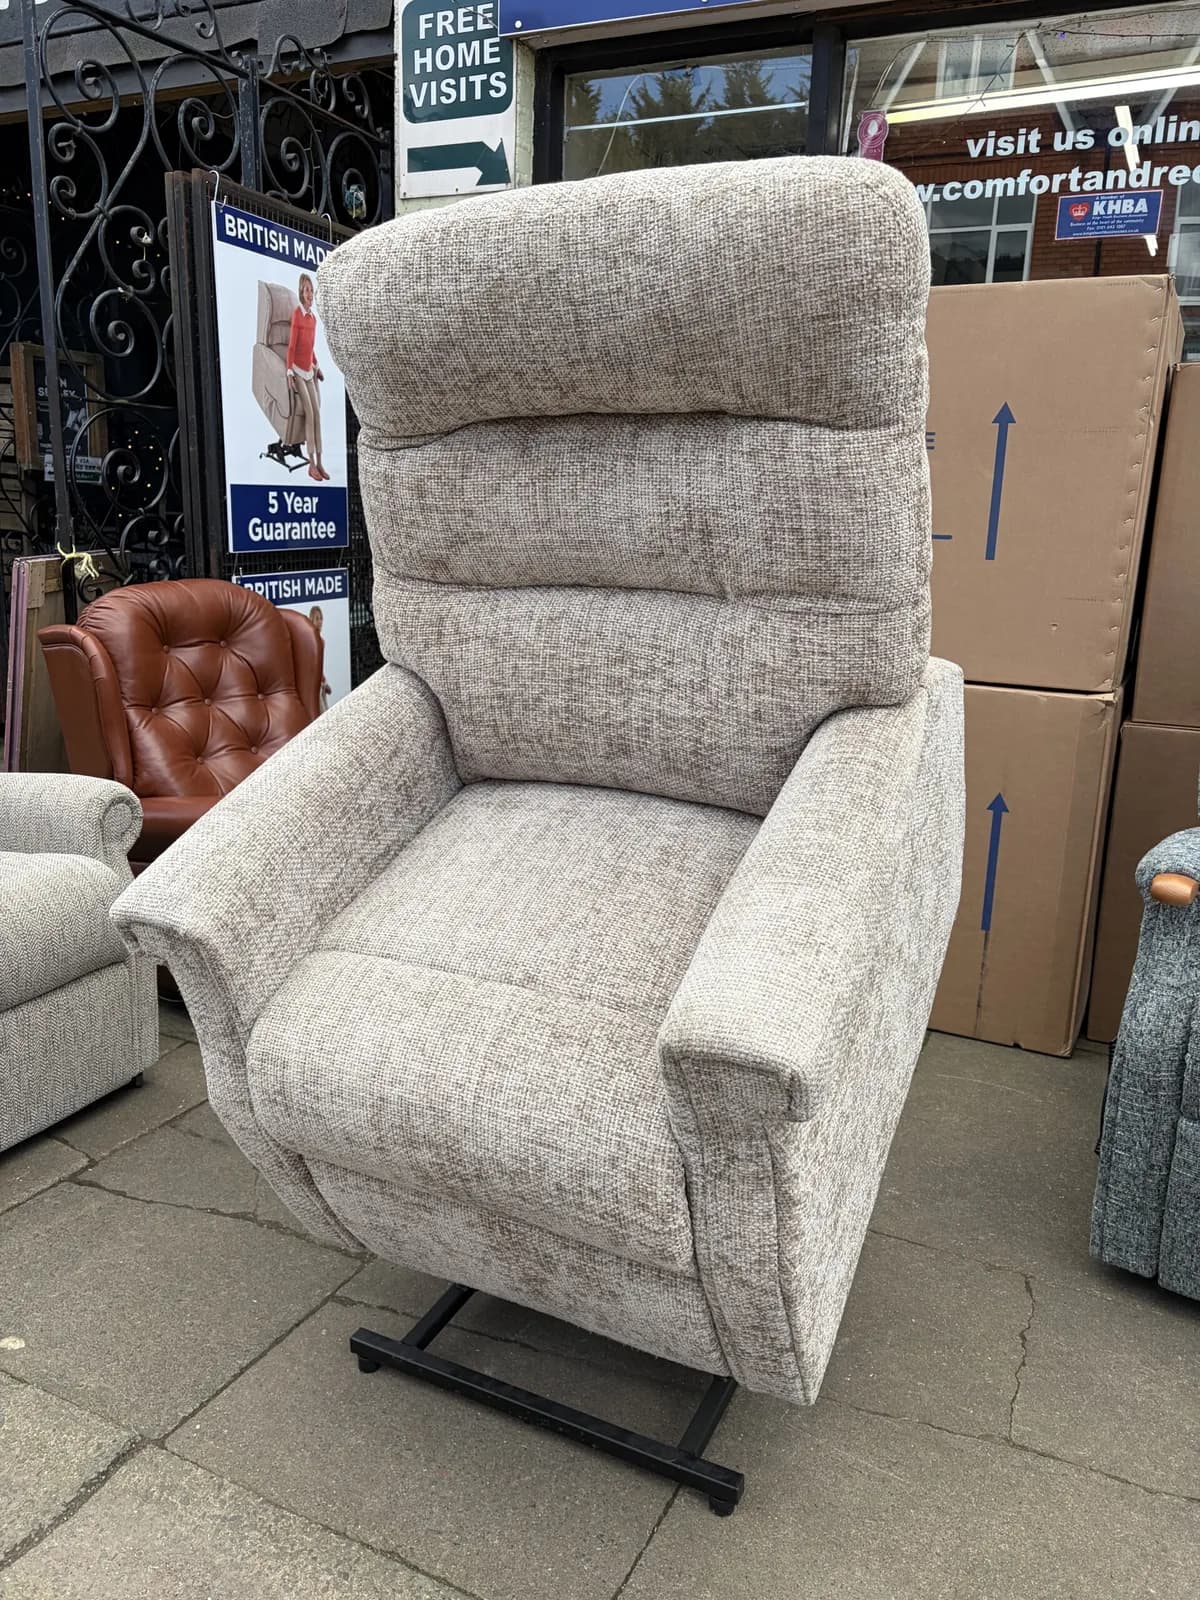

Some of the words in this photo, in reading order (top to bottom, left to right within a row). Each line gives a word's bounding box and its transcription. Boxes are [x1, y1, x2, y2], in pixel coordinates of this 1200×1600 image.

[420, 3, 494, 39] FREE
[414, 37, 501, 75] HOME
[409, 71, 507, 108] VISITS
[966, 127, 1042, 158] visit
[1053, 128, 1095, 151] us
[1092, 198, 1148, 216] KHBA
[224, 213, 289, 255] BRITISH
[294, 238, 332, 265] MAD
[268, 491, 279, 514] 5
[283, 491, 319, 514] Year
[248, 517, 337, 542] Guarantee
[305, 575, 343, 597] MADE
